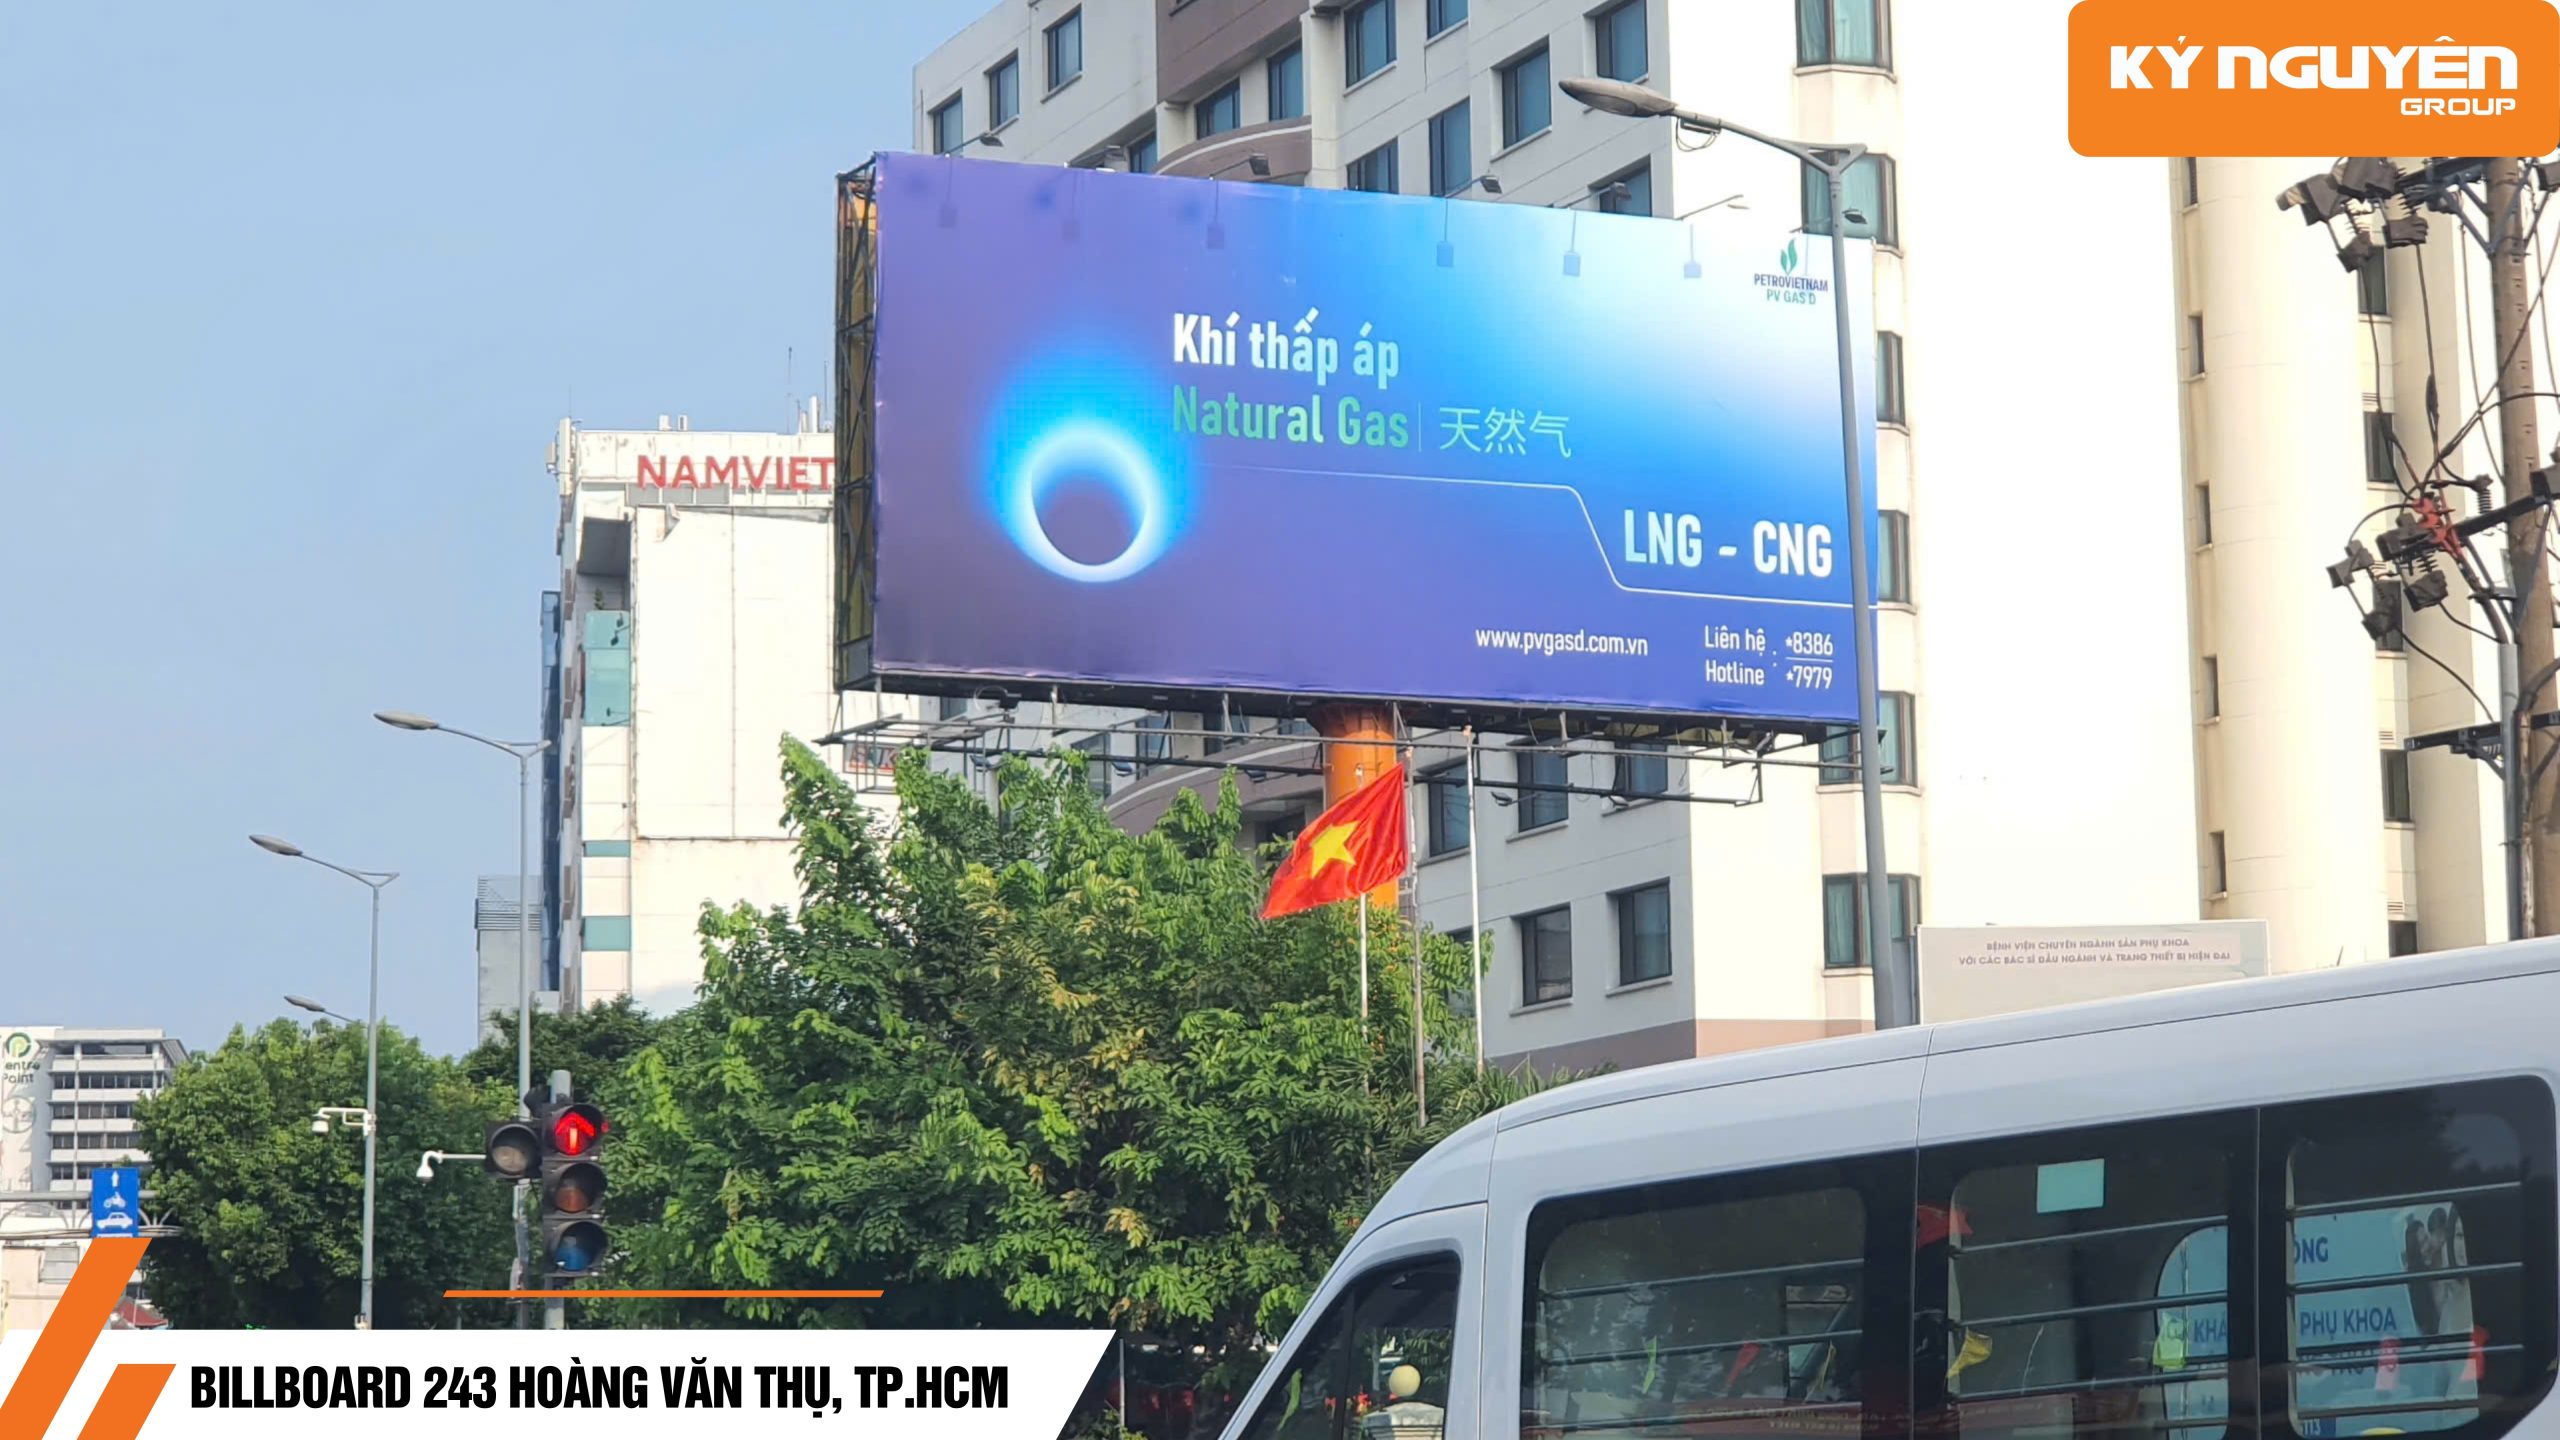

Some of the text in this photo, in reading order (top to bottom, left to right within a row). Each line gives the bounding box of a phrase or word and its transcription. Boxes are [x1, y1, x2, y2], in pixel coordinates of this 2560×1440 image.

[1753, 273, 1829, 292] PETROVIETNAM
[1766, 289, 1781, 302] PV
[1783, 290, 1806, 305] GAS
[1173, 306, 1399, 390] Khí thấp áp
[1173, 384, 1410, 448] Natural Gas
[1439, 406, 1572, 459] 天然气
[637, 454, 838, 491] NAMVIET
[1623, 508, 1702, 568] LNG
[1753, 519, 1833, 578] CNG
[1475, 628, 1649, 657] www.pvgasd.com.vn
[1704, 624, 1740, 650] Liên
[1745, 627, 1766, 657] hệ
[1705, 659, 1765, 686] Hotline
[2300, 1309, 2338, 1341] PHỤ
[2343, 1306, 2398, 1334] KHOA
